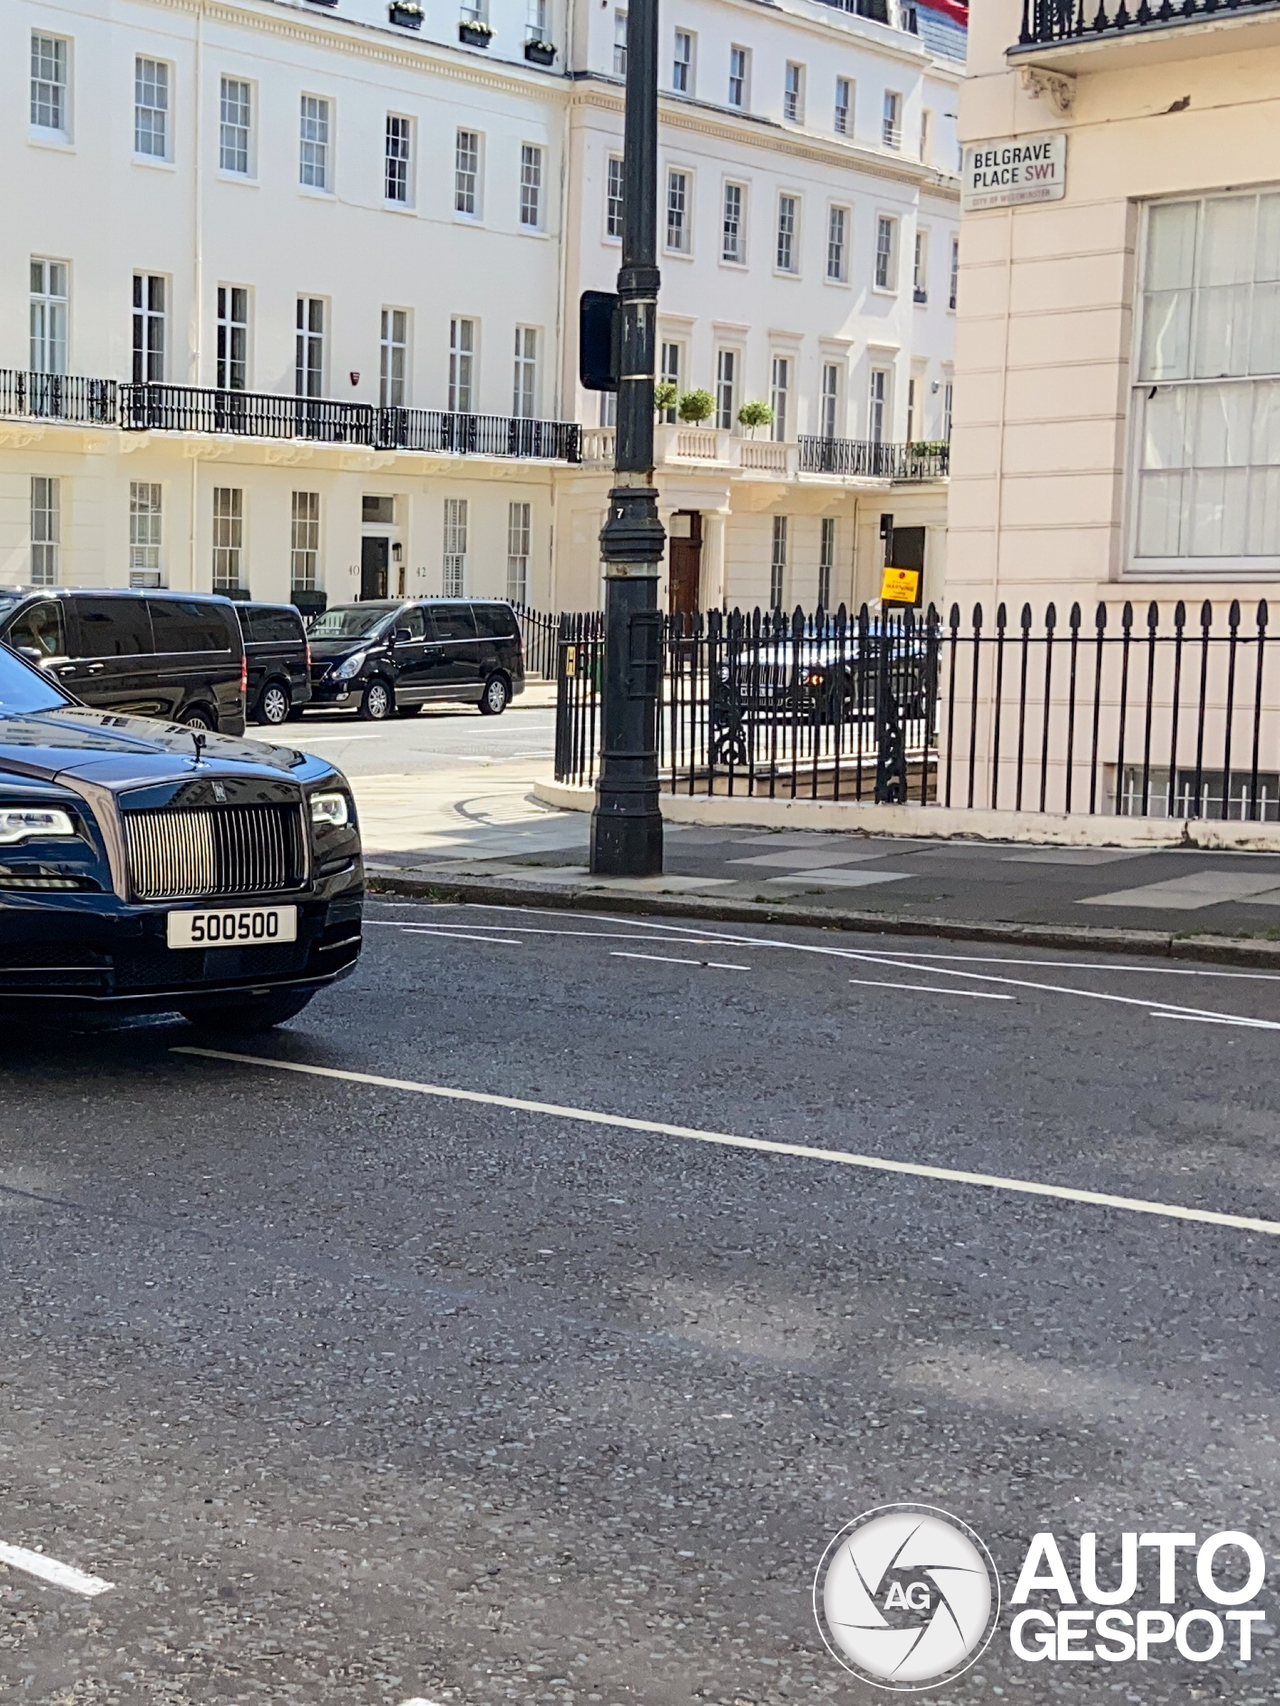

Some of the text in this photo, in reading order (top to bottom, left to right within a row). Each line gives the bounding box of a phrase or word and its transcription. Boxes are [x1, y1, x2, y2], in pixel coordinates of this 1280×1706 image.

[974, 143, 1052, 169] BELGRAVE
[973, 162, 1055, 189] PLACE SW1
[972, 197, 987, 207] CITY
[616, 508, 624, 519] 7
[416, 567, 426, 577] 42
[191, 912, 278, 941] 500500
